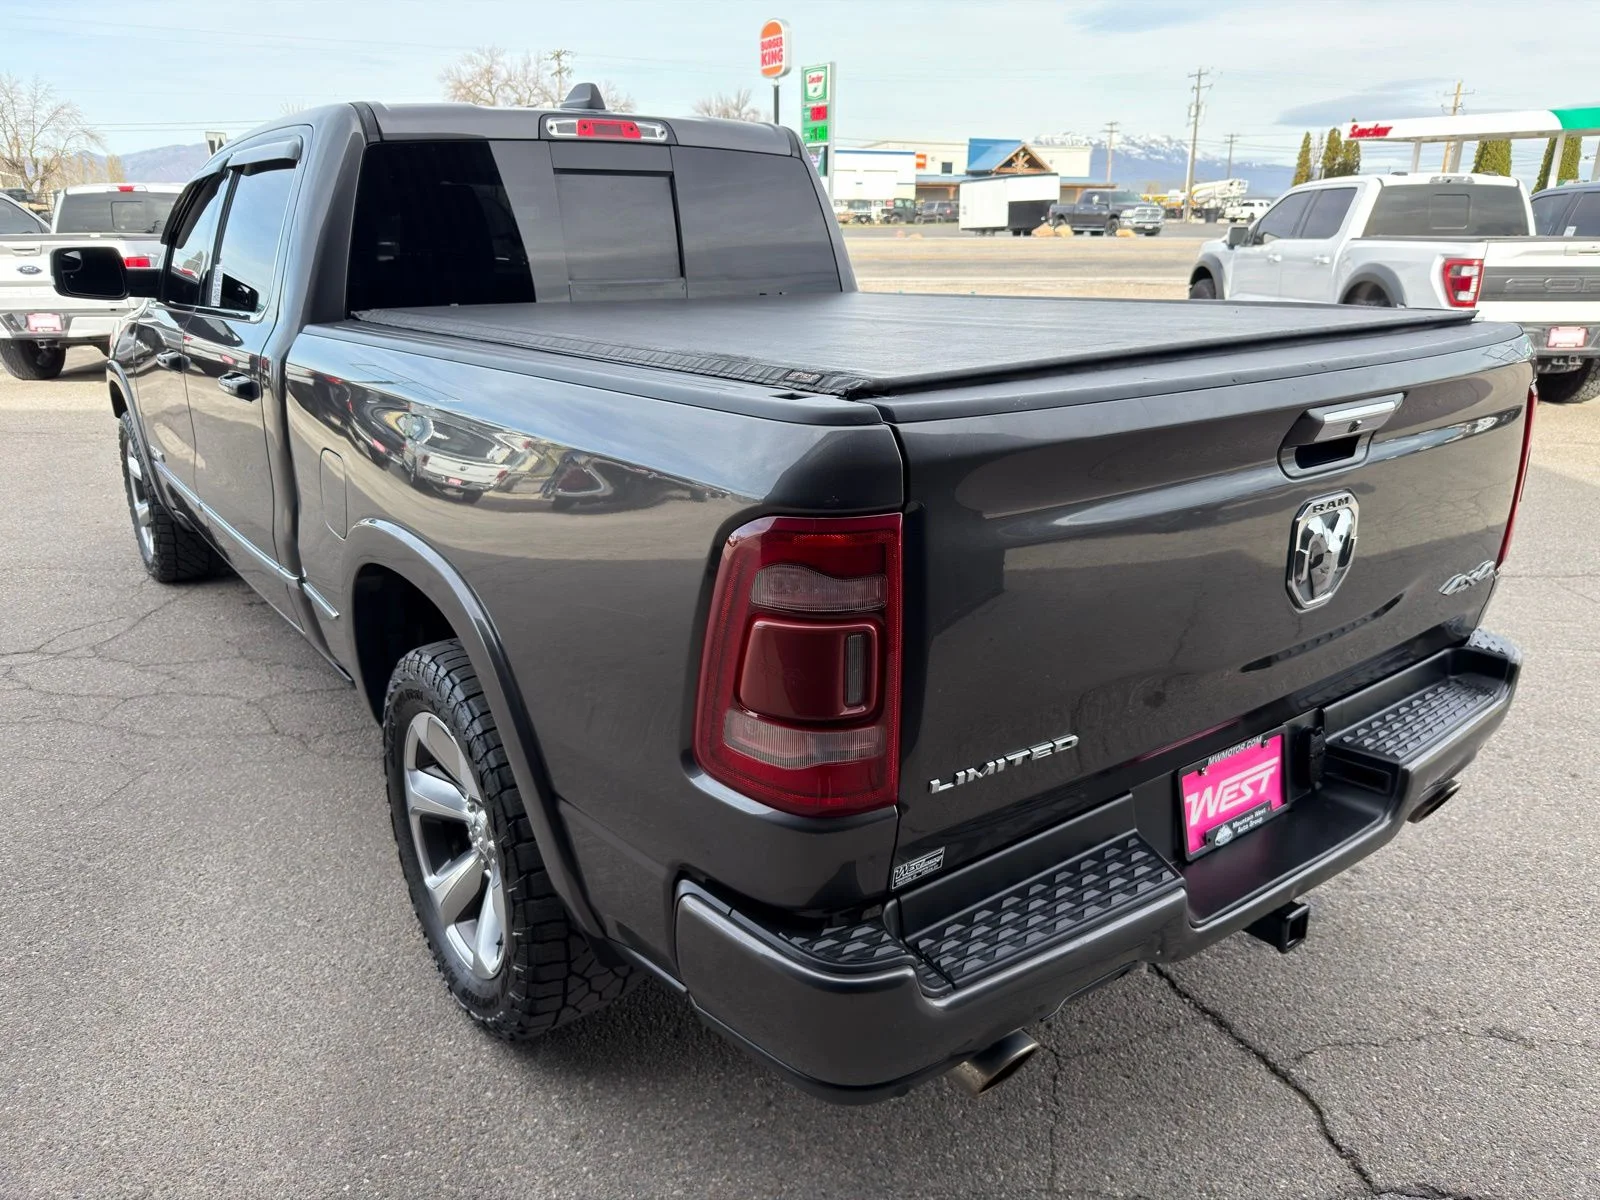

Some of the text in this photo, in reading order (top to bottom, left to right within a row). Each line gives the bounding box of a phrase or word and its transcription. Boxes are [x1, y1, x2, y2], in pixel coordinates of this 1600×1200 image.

[760, 36, 783, 51] BURGER
[761, 48, 783, 67] KING
[1312, 496, 1350, 513] RAM
[1207, 736, 1263, 766] MWMOTOR.COM
[928, 733, 1080, 794] LIMITED
[1184, 757, 1280, 827] WEST
[1232, 807, 1266, 829] Mountain West
[1237, 817, 1263, 833] Auto Group
